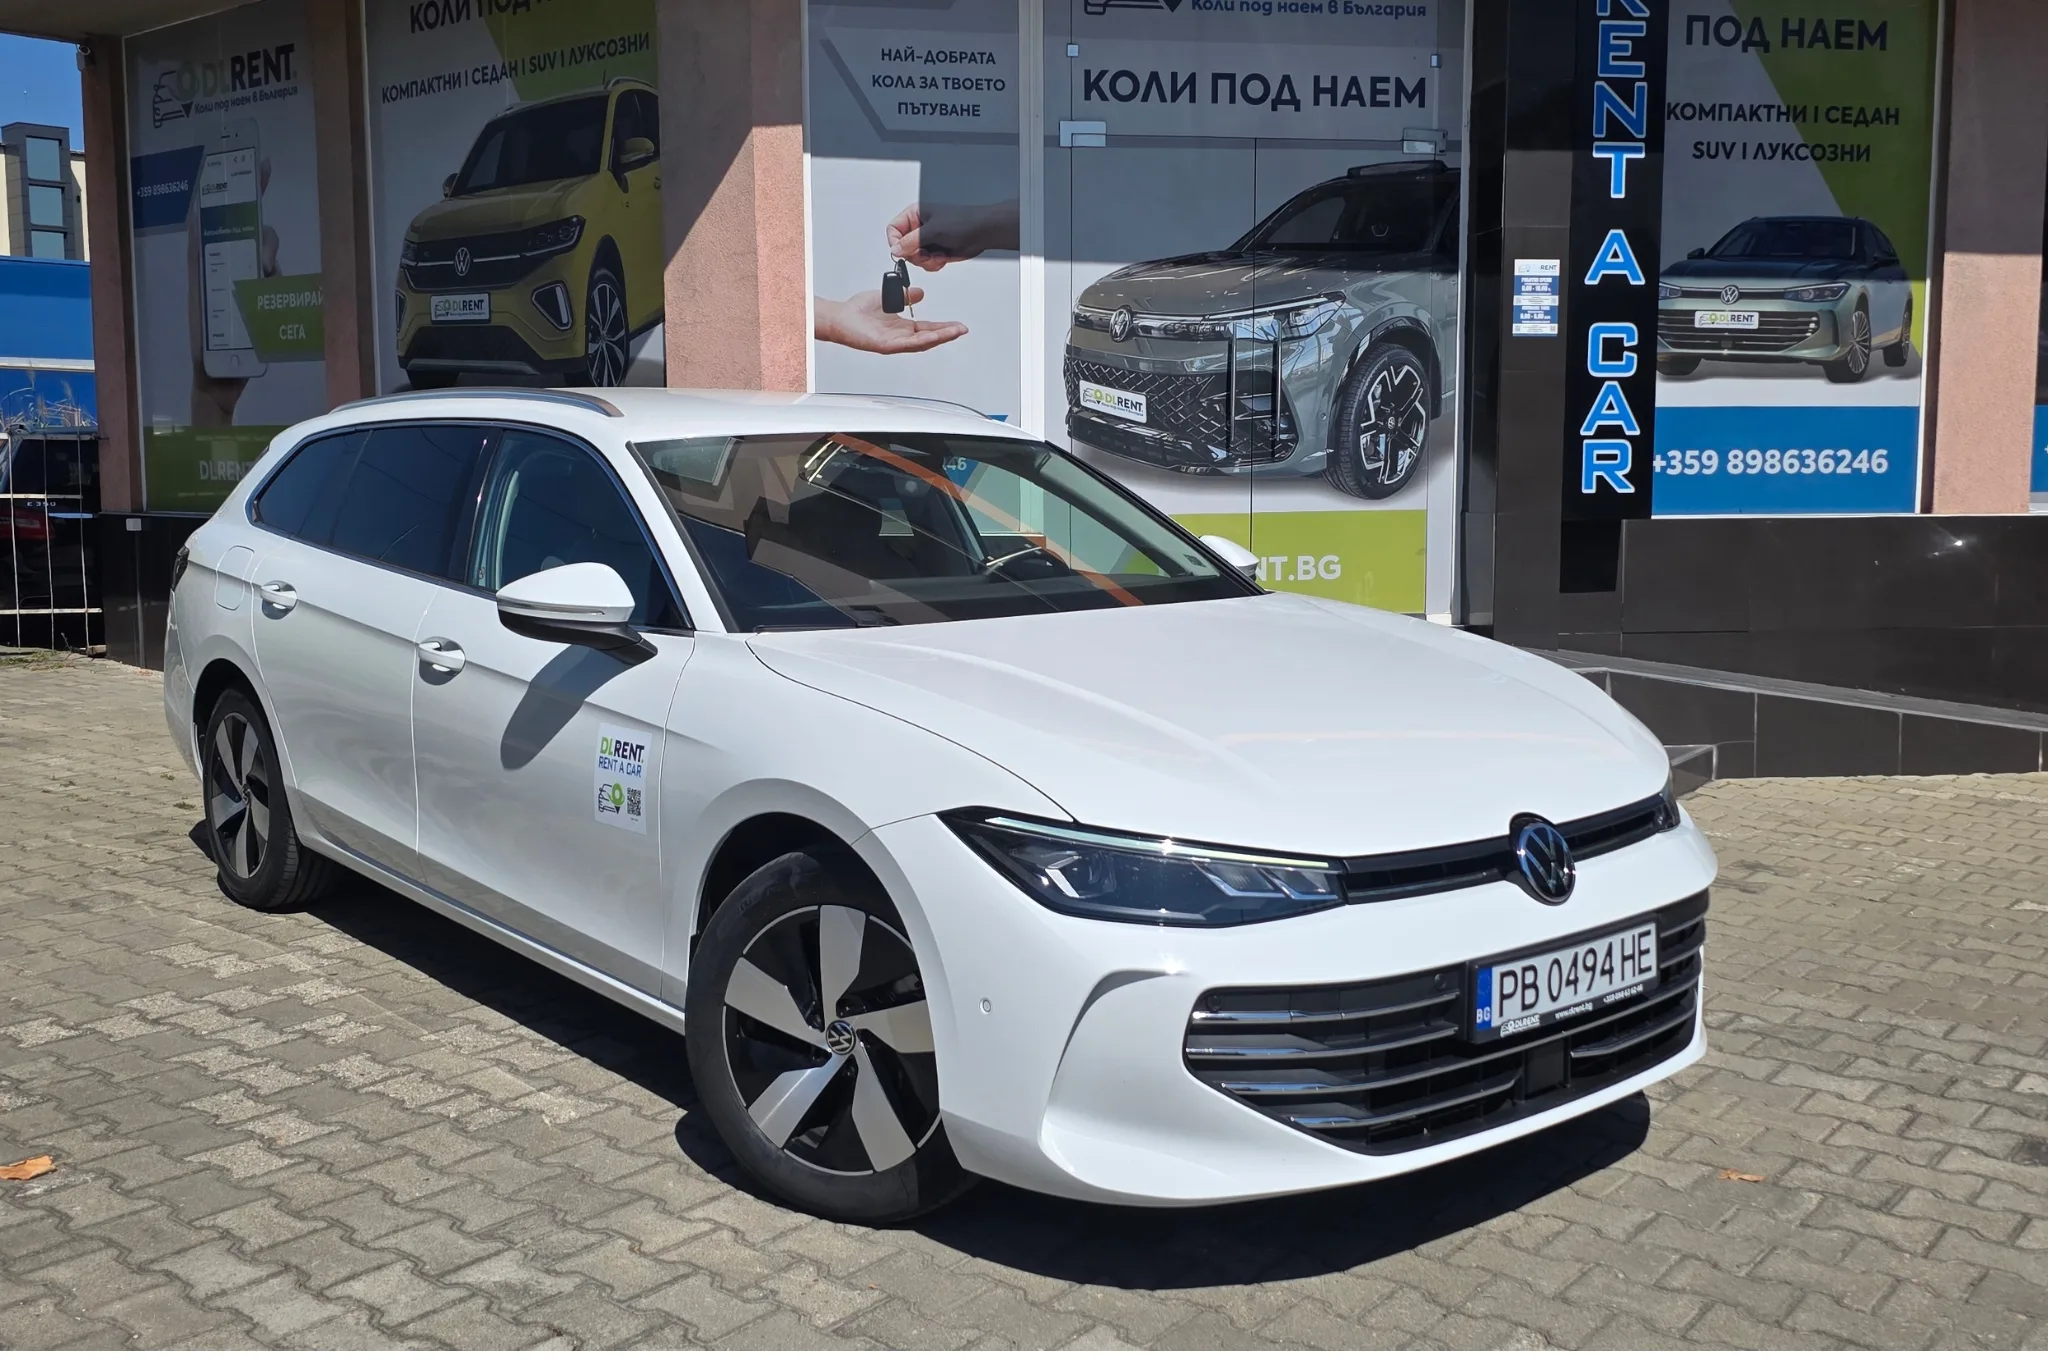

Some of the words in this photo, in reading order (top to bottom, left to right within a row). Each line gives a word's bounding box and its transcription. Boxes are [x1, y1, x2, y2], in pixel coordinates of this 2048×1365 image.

[410, 0, 470, 33] КОЛИ
[1192, 0, 1234, 11] Коли
[1240, 1, 1272, 16] под
[1278, 2, 1323, 14] наем
[1344, 0, 1426, 19] България
[1686, 15, 1770, 53] ПОД
[1782, 18, 1887, 51] НАЕМ
[381, 72, 462, 104] КОМПАКТНИ
[471, 60, 518, 84] СЕДАН
[529, 52, 558, 74] SUV
[568, 32, 650, 66] ЛУКСОЗНИ
[880, 46, 996, 66] НАЙ-ДОБРАТА
[872, 74, 915, 90] КОЛА
[920, 76, 939, 90] ЗА
[942, 76, 1006, 92] ТВОЕТО
[1083, 68, 1197, 104] КОЛИ
[1211, 72, 1301, 112] ПОД
[1312, 75, 1426, 108] НАЕМ
[897, 101, 981, 117] ПЪТУВАНЕ
[1592, 0, 1650, 198] ENT
[1666, 102, 1806, 123] КОМПАКТНИ
[1825, 106, 1900, 128] СЕДАН
[1692, 141, 1736, 160] SUV
[1753, 142, 1870, 162] ЛУКСОЗНИ
[1584, 229, 1646, 286] A
[279, 324, 306, 340] СЕГА
[1580, 322, 1640, 494] CAR
[1652, 450, 1719, 475] +359
[1726, 448, 1888, 476] 898636246
[598, 756, 618, 772] RENT
[618, 761, 624, 774] A
[626, 763, 642, 778] CAR
[1499, 964, 1539, 1018] PB
[1547, 942, 1614, 1002] 0494
[1620, 929, 1652, 982] HE
[1476, 1008, 1491, 1024] BG
